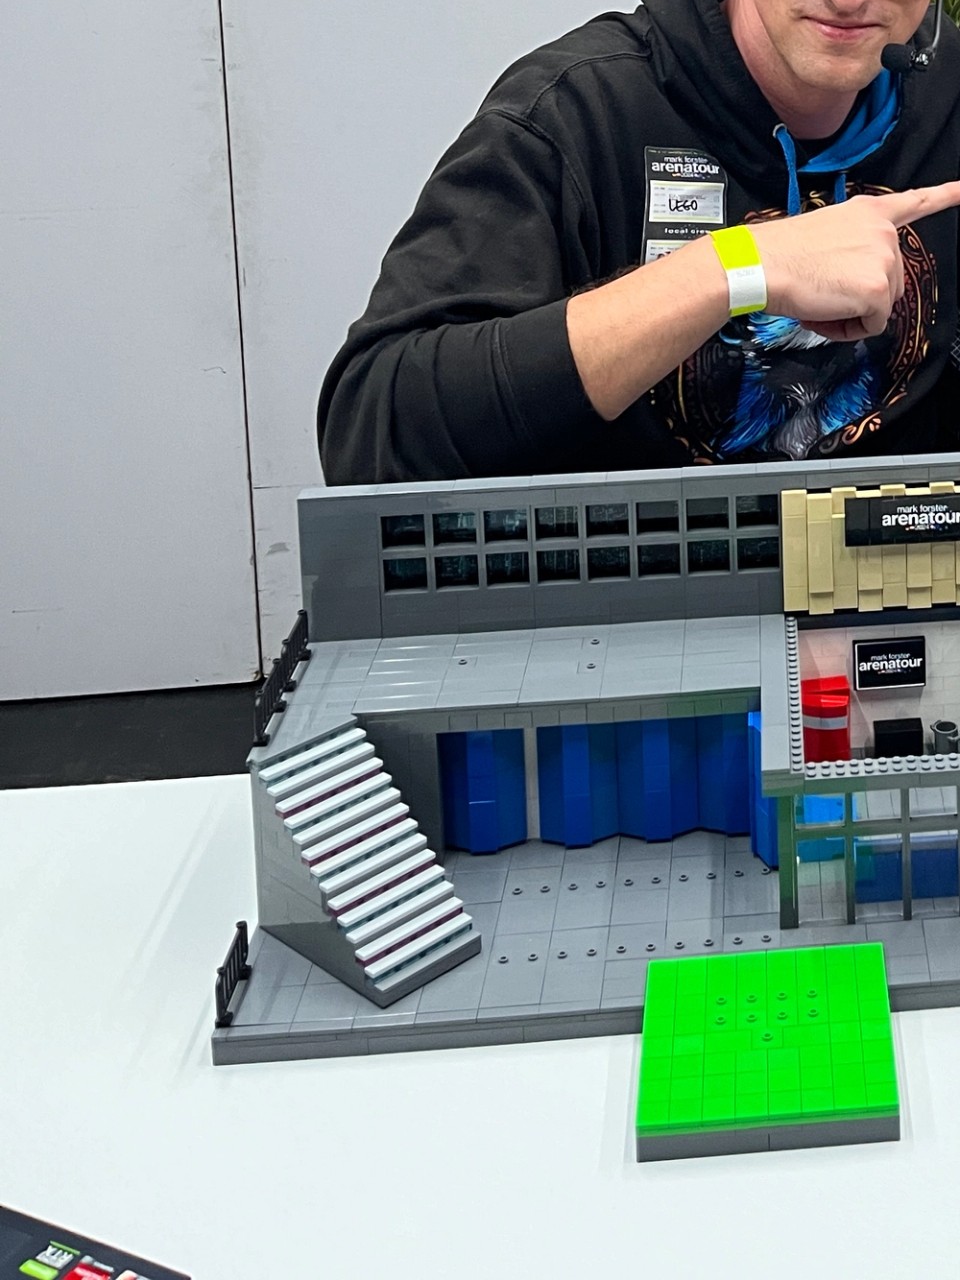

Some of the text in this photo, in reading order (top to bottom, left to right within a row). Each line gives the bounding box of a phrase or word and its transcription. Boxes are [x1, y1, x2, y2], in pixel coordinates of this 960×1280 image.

[651, 161, 720, 174] arenatour
[896, 504, 948, 514] mark forster
[888, 652, 911, 660] forster
[858, 657, 923, 672] arenatour
